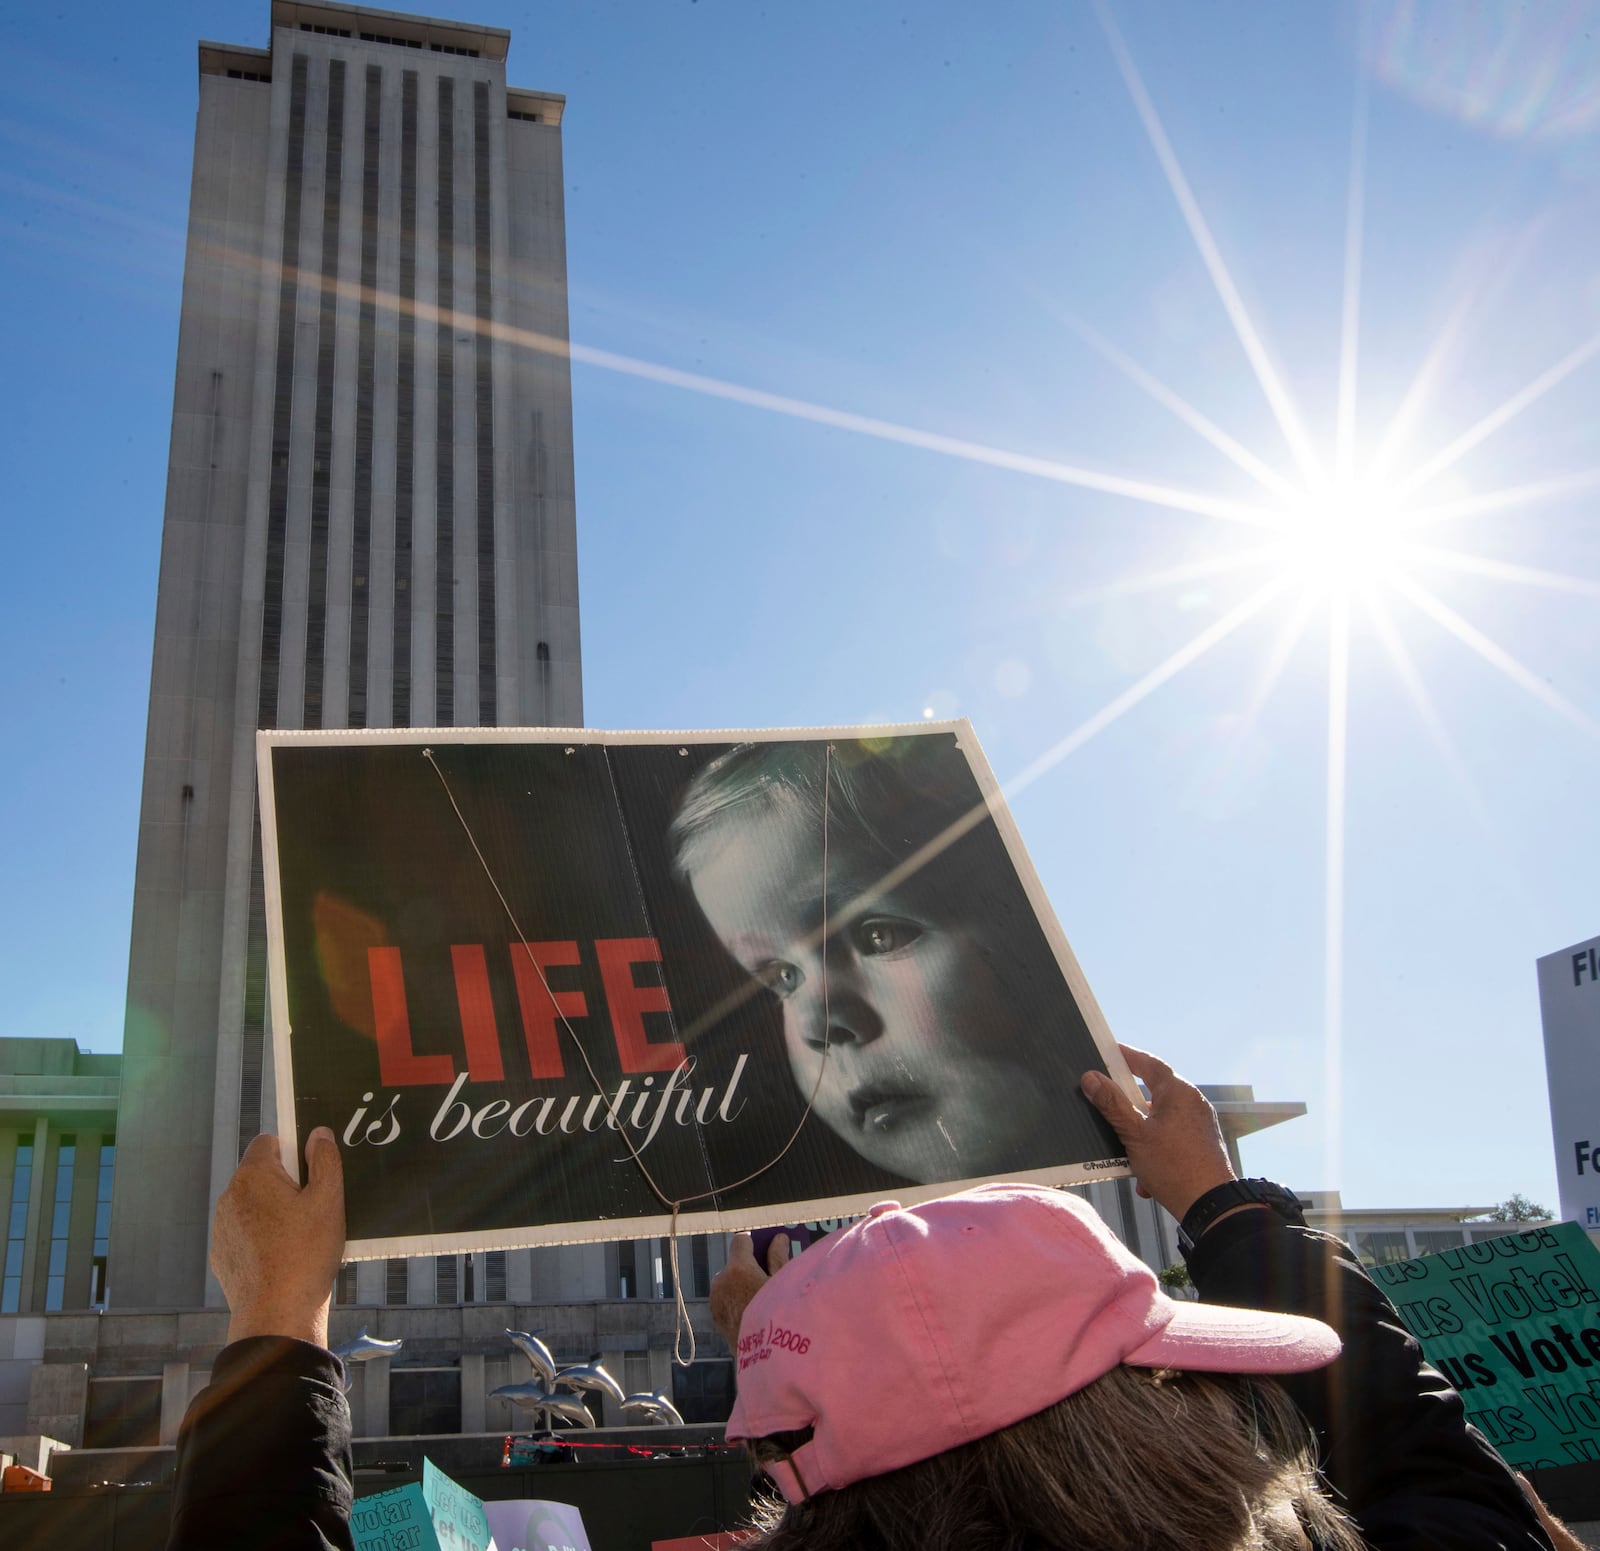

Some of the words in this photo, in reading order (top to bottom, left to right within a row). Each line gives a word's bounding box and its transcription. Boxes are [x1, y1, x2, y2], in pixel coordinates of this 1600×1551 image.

[1571, 947, 1600, 987] Fl
[367, 937, 690, 1087] LIFE
[342, 1091, 402, 1148] is
[429, 1053, 749, 1163] beautiful
[1586, 1206, 1600, 1224] Fl
[1400, 1297, 1464, 1340] us
[1449, 1252, 1600, 1326] Vote!
[1435, 1353, 1498, 1392] us
[1467, 1405, 1537, 1447] us
[1522, 1378, 1600, 1436] Vo
[351, 1498, 412, 1534] votar
[431, 1478, 458, 1520] Let
[460, 1507, 482, 1536] us
